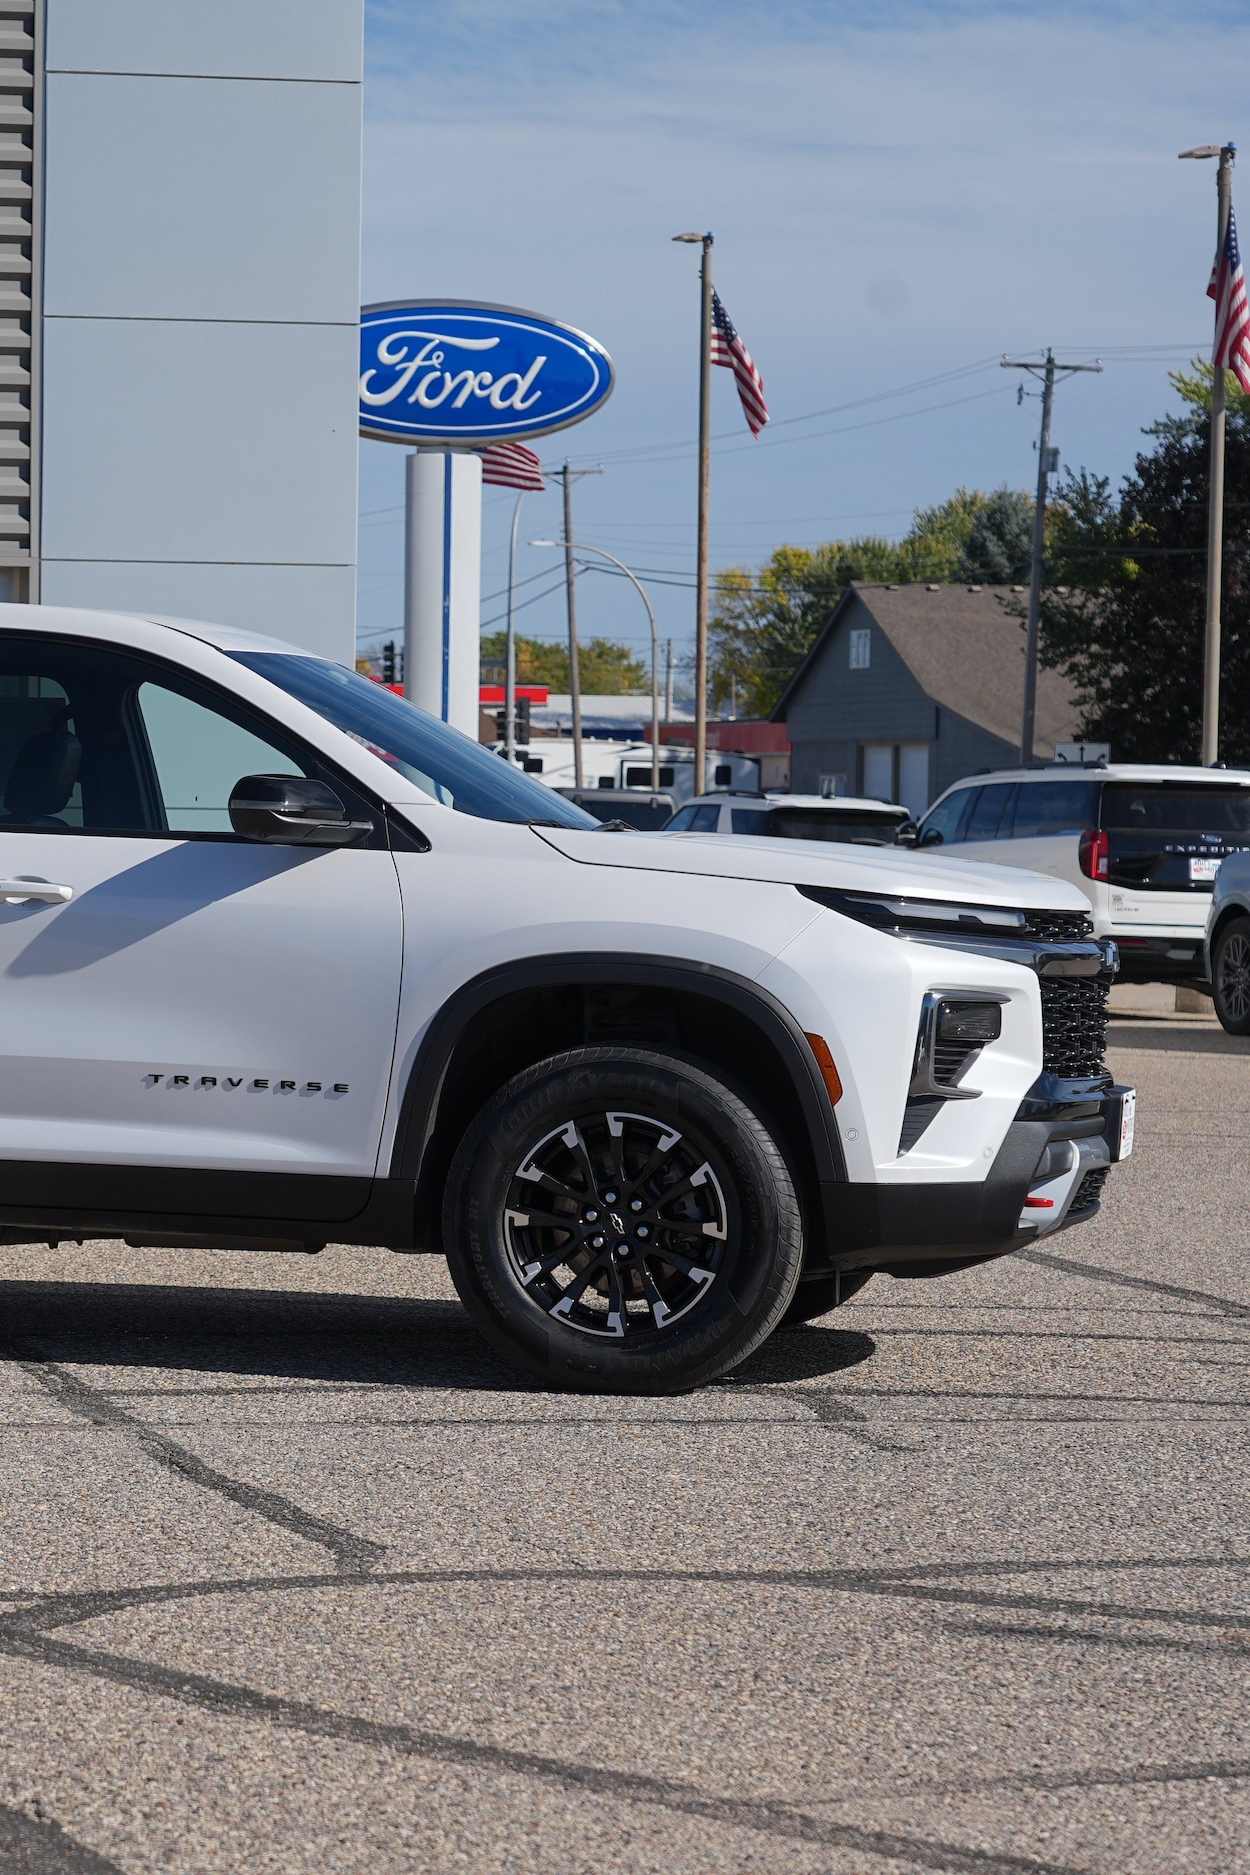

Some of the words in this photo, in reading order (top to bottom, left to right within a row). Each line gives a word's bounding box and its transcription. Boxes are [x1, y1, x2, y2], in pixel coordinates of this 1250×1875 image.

[360, 331, 547, 411] Ford
[147, 1073, 349, 1093] TRAVERSE
[469, 1196, 480, 1220] HT
[469, 1230, 510, 1319] TERRITORY
